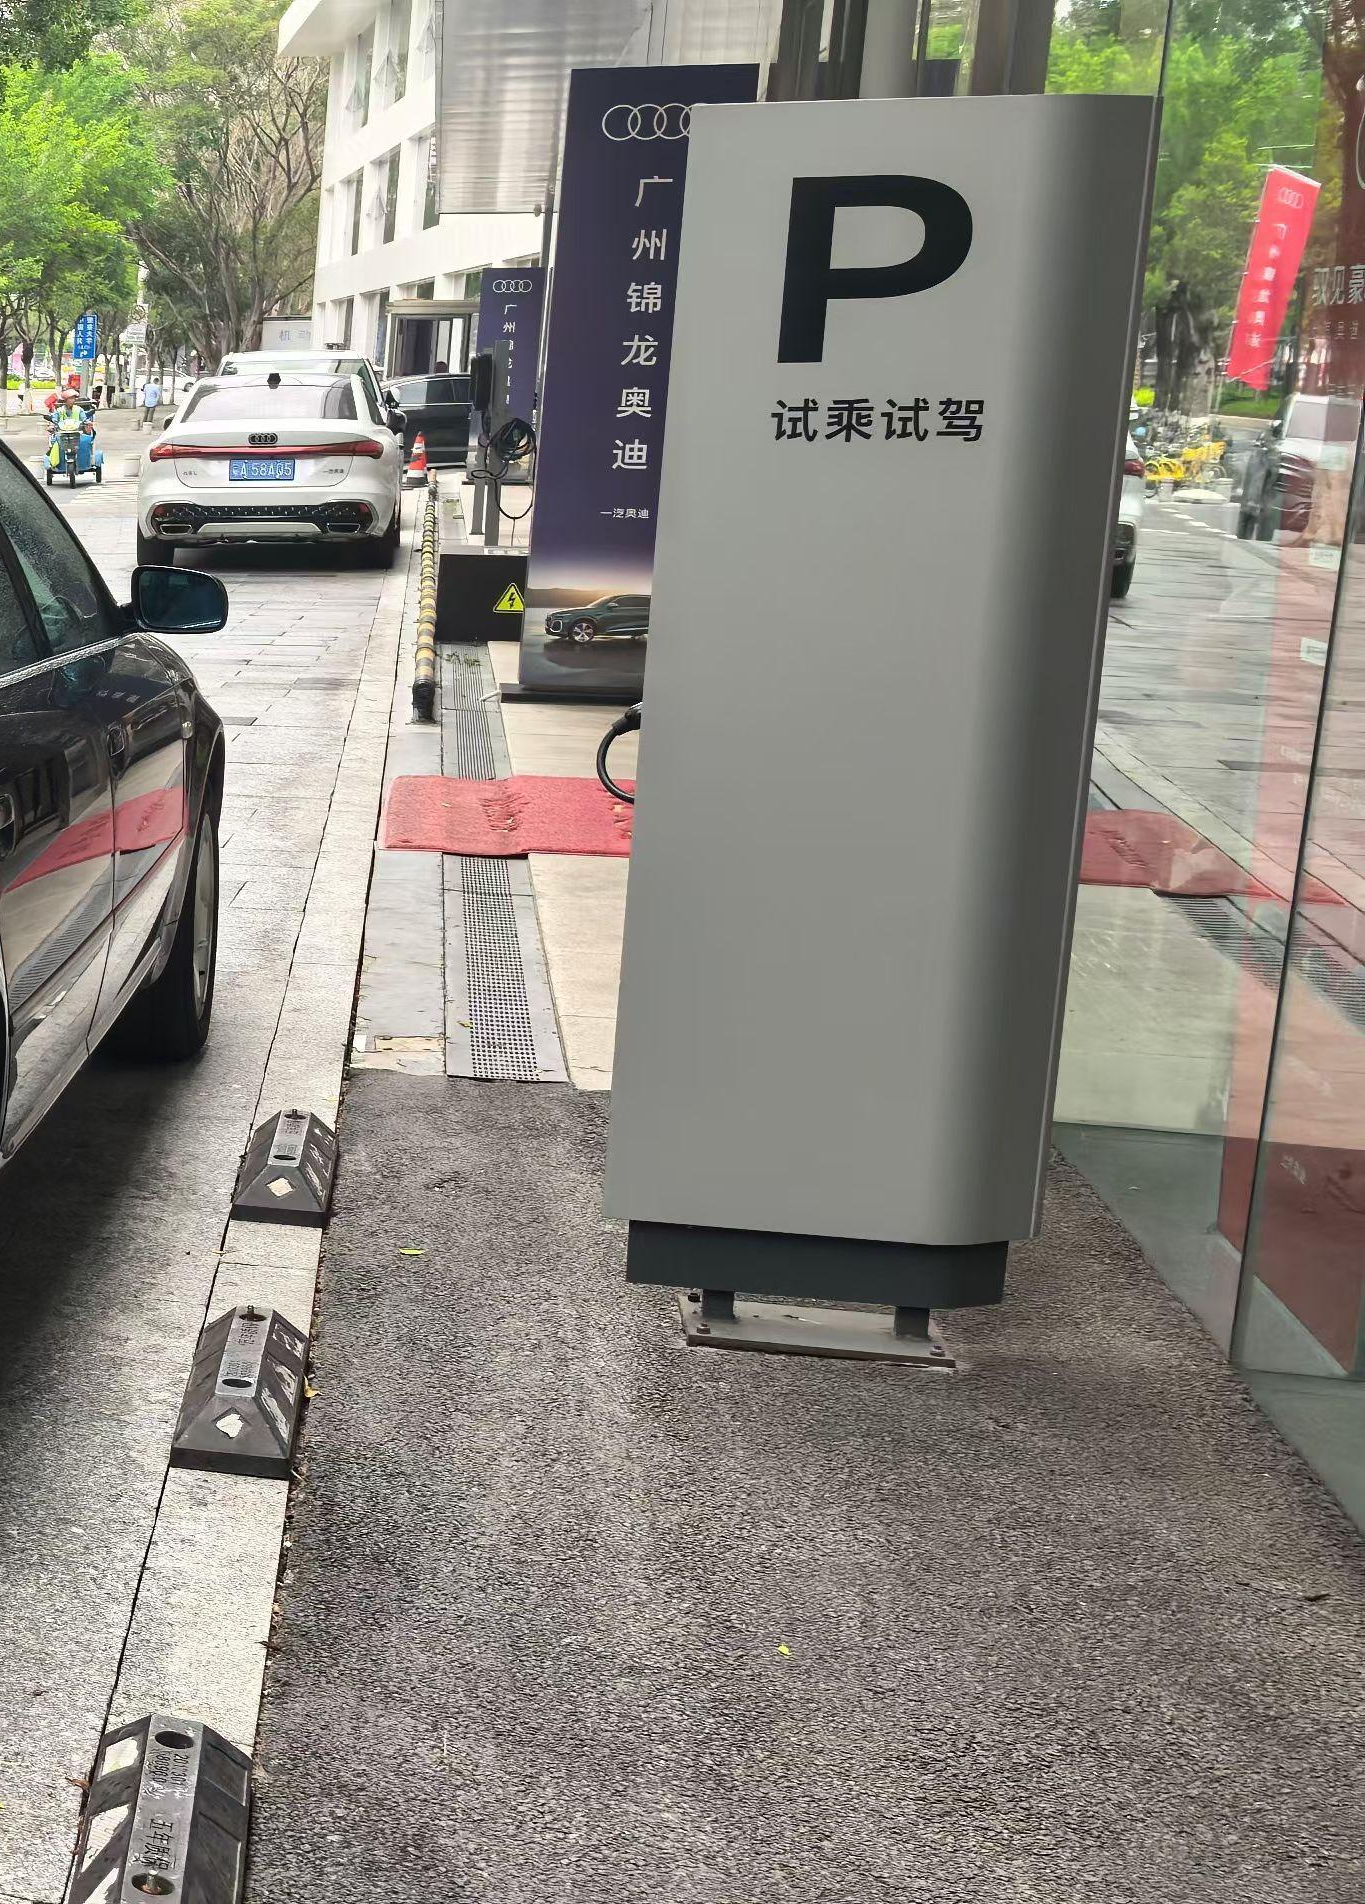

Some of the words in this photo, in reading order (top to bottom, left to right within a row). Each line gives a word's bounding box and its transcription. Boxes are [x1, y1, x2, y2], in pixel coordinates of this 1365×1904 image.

[777, 174, 974, 364] P
[1312, 263, 1365, 305] 驭见豪
[611, 175, 675, 472] 广州锦龙奥迪
[770, 397, 985, 443] 试乘试驾
[599, 507, 650, 519] 一汽奥迪
[144, 1817, 174, 1871] 五年质保
